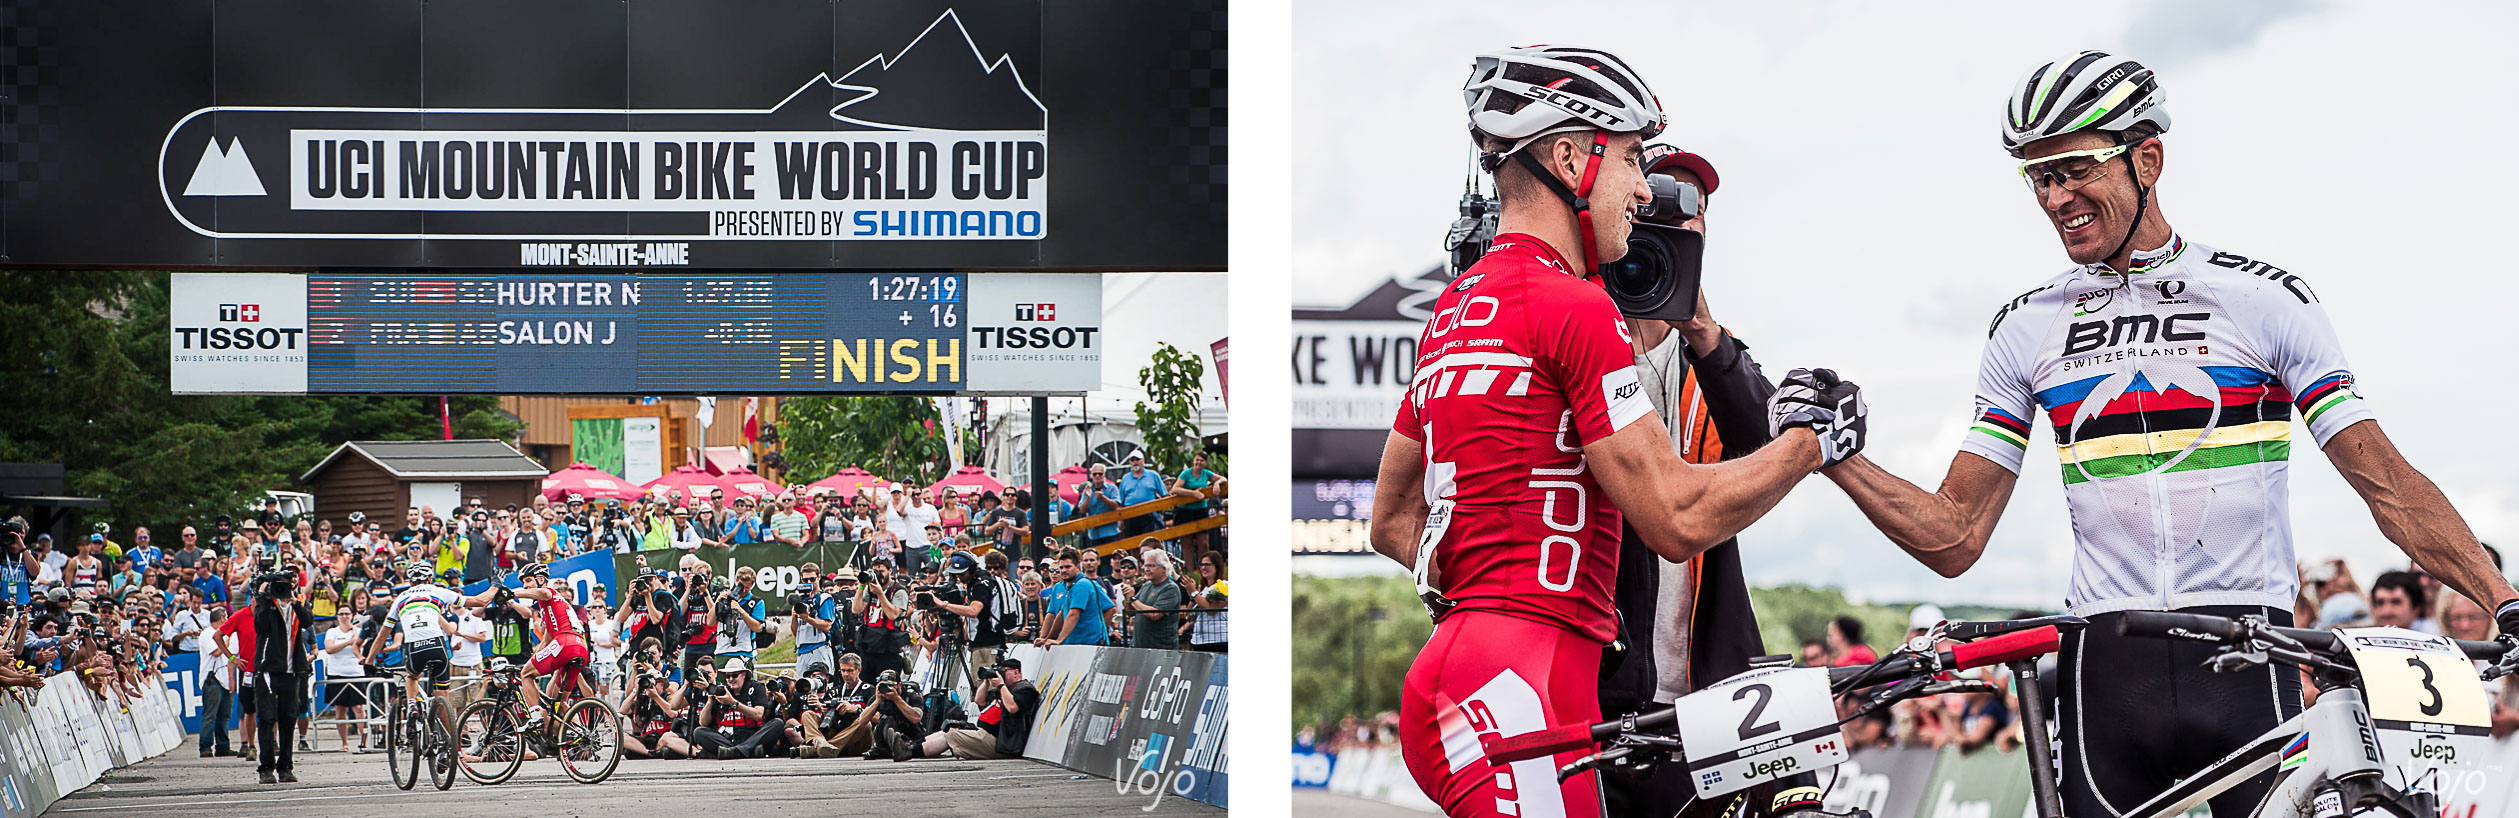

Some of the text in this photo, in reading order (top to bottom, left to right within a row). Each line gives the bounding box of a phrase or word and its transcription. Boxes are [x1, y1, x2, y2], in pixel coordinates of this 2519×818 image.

[2097, 69, 2125, 91] GIRO
[1524, 86, 1625, 126] SCOTT
[2133, 96, 2155, 118] BMC
[307, 139, 1045, 200] UCI MOUNTAIN BIKE WORLD CUP
[715, 211, 1041, 236] PRESENTED BY SHIMANO
[520, 243, 689, 266] MONT-SAINTE-ANNE
[1487, 242, 1516, 253] SCOTT
[869, 276, 957, 301] 1:27:19
[930, 304, 957, 328] 16
[174, 327, 304, 350] TISSOT
[601, 321, 616, 344] J
[971, 326, 1099, 349] TISSOT
[1466, 338, 1503, 348] SRAM
[2061, 313, 2211, 357] BMC
[2063, 347, 2188, 372] SWITZERLAND
[728, 557, 801, 598] Jep
[414, 638, 436, 648] BMC
[2406, 657, 2443, 717] 3
[1733, 683, 1782, 742] 2
[2353, 710, 2379, 763] BMC
[2410, 738, 2456, 764] Jeep
[1743, 756, 1797, 780] Jeep
